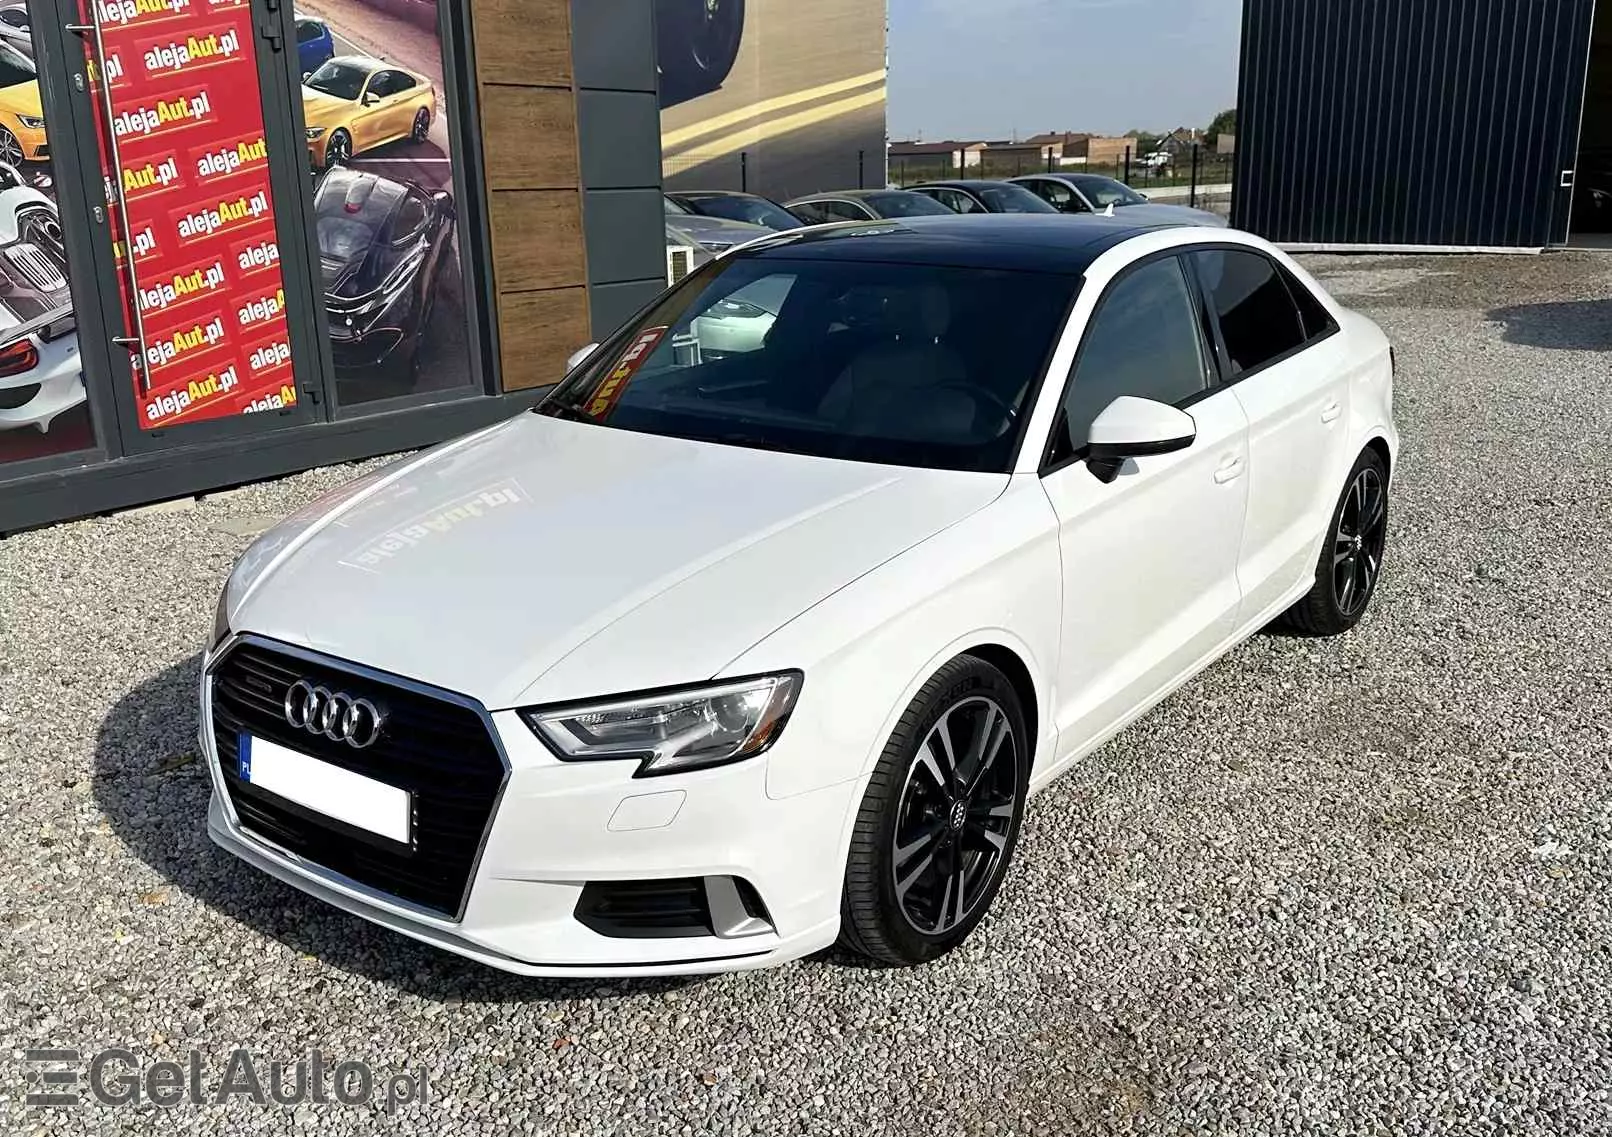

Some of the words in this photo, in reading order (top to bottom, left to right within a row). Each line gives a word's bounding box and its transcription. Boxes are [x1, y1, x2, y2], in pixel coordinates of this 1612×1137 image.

[144, 29, 240, 70] alejaAut.pl
[113, 91, 211, 136] alejaAut.pl
[178, 191, 268, 237] alejaAut.pl
[238, 242, 280, 270] aleja
[139, 262, 225, 311] lejaAut.pl
[131, 317, 225, 370] aejaAut.pl
[250, 342, 291, 370] aleja
[146, 366, 239, 420] alejaAut.pl
[242, 761, 252, 776] PL
